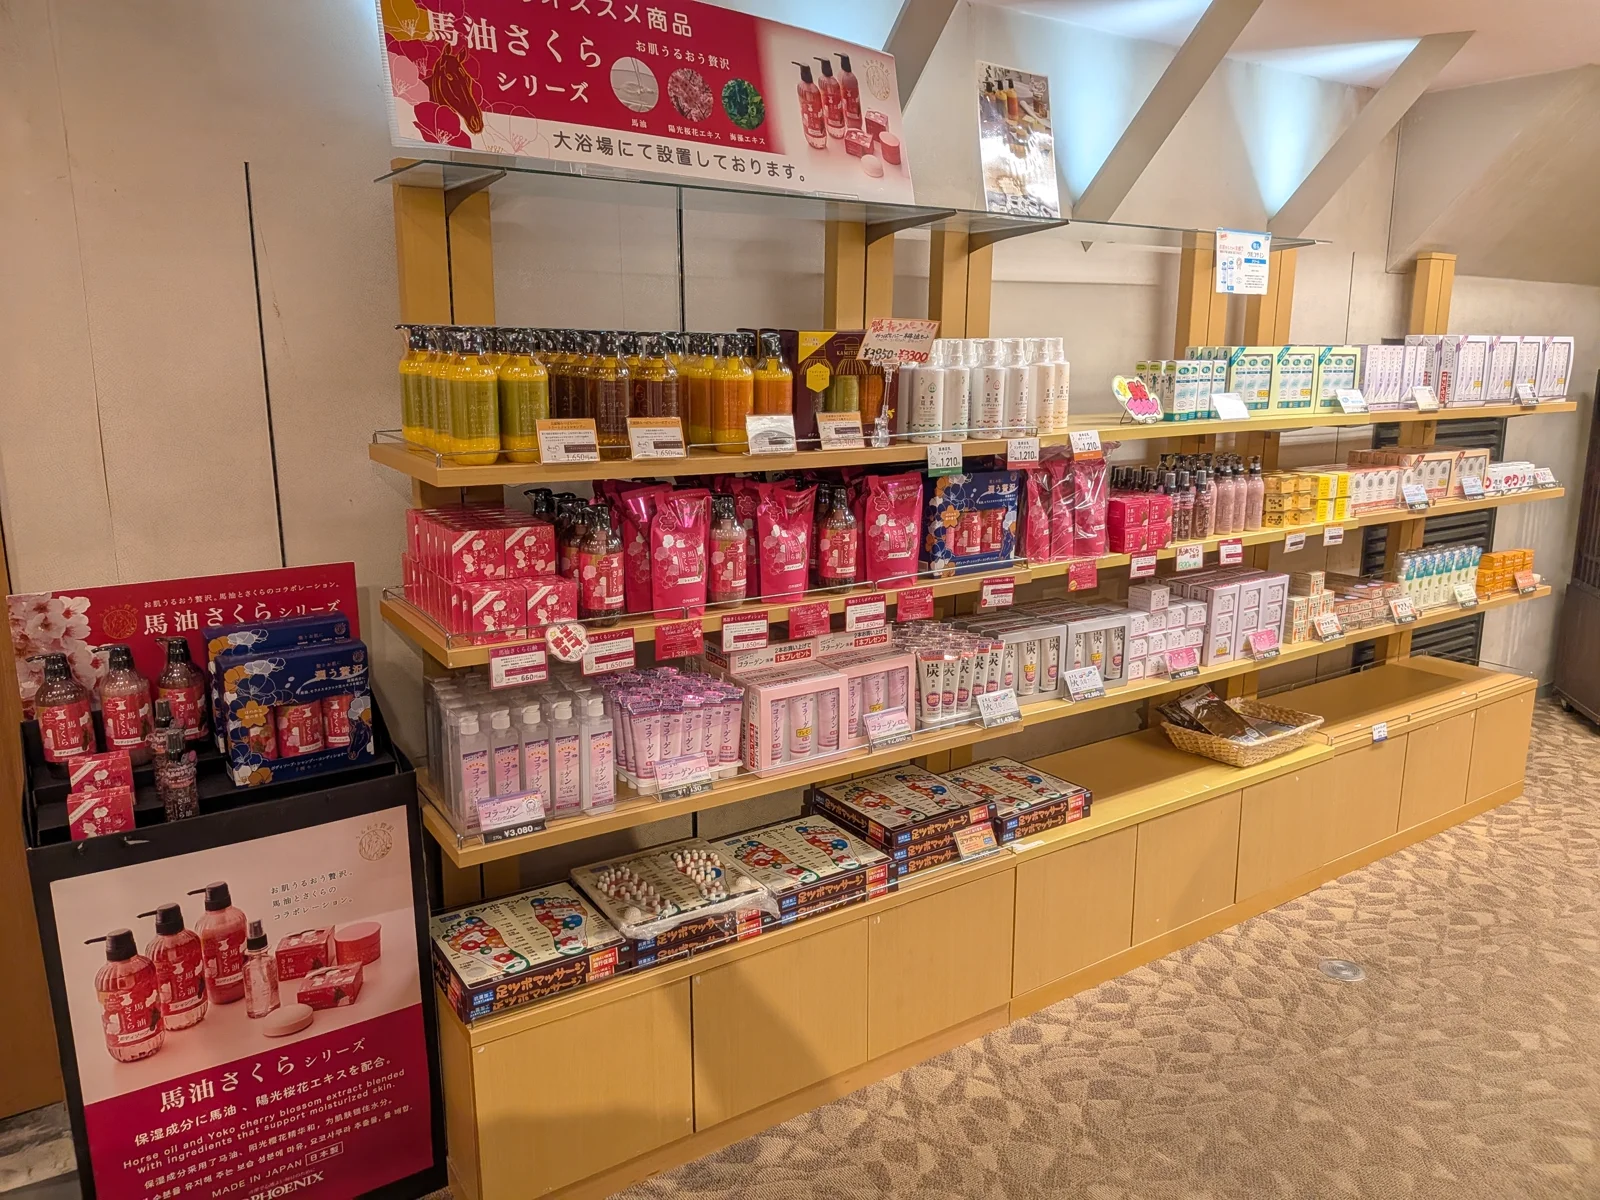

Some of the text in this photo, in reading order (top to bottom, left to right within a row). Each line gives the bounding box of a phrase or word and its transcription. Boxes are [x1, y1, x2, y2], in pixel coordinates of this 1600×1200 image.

[426, 9, 601, 68] 馬油さくら
[635, 40, 730, 71] お肌うるおう贅沢
[497, 72, 589, 103] シリーズ
[631, 118, 648, 129] 馬油
[668, 124, 721, 140] 陽光桜花エキス
[729, 132, 766, 145] 海藻エキス
[553, 130, 806, 182] 大浴場にて設置しております。
[143, 599, 341, 635] 馬油さくら シリーズ
[775, 650, 811, 663] 1本プレゼント
[926, 663, 939, 678] 炭
[661, 767, 695, 780] コラーゲン
[485, 805, 519, 818] コラーゲン
[1018, 801, 1067, 825] 足ツボマッサージ
[504, 825, 534, 837] ¥3,080
[911, 814, 968, 840] 足ツボマッサージ
[270, 869, 353, 894] お肌うるおう贅沢。
[798, 874, 864, 905] 足ツボマッサージ
[272, 886, 337, 908] 馬油とさくらの
[274, 897, 353, 920] コラボレーション。
[495, 961, 587, 1000] 足ツボマッサージ
[160, 1038, 366, 1112] 馬油さくら シリーズ
[134, 1057, 391, 1147] 保湿成分に馬油、陽光桜花エキスを配合。
[123, 1068, 405, 1169] Horse oil and Yoko cherry blossom extract blended
[137, 1083, 396, 1174] with ingredients that support moisturized skin.
[185, 1174, 213, 1191] 유지해
[216, 1168, 234, 1180] 주는
[211, 1180, 246, 1198] MADE
[250, 1174, 261, 1184] IN
[265, 1160, 303, 1178] JAPAN
